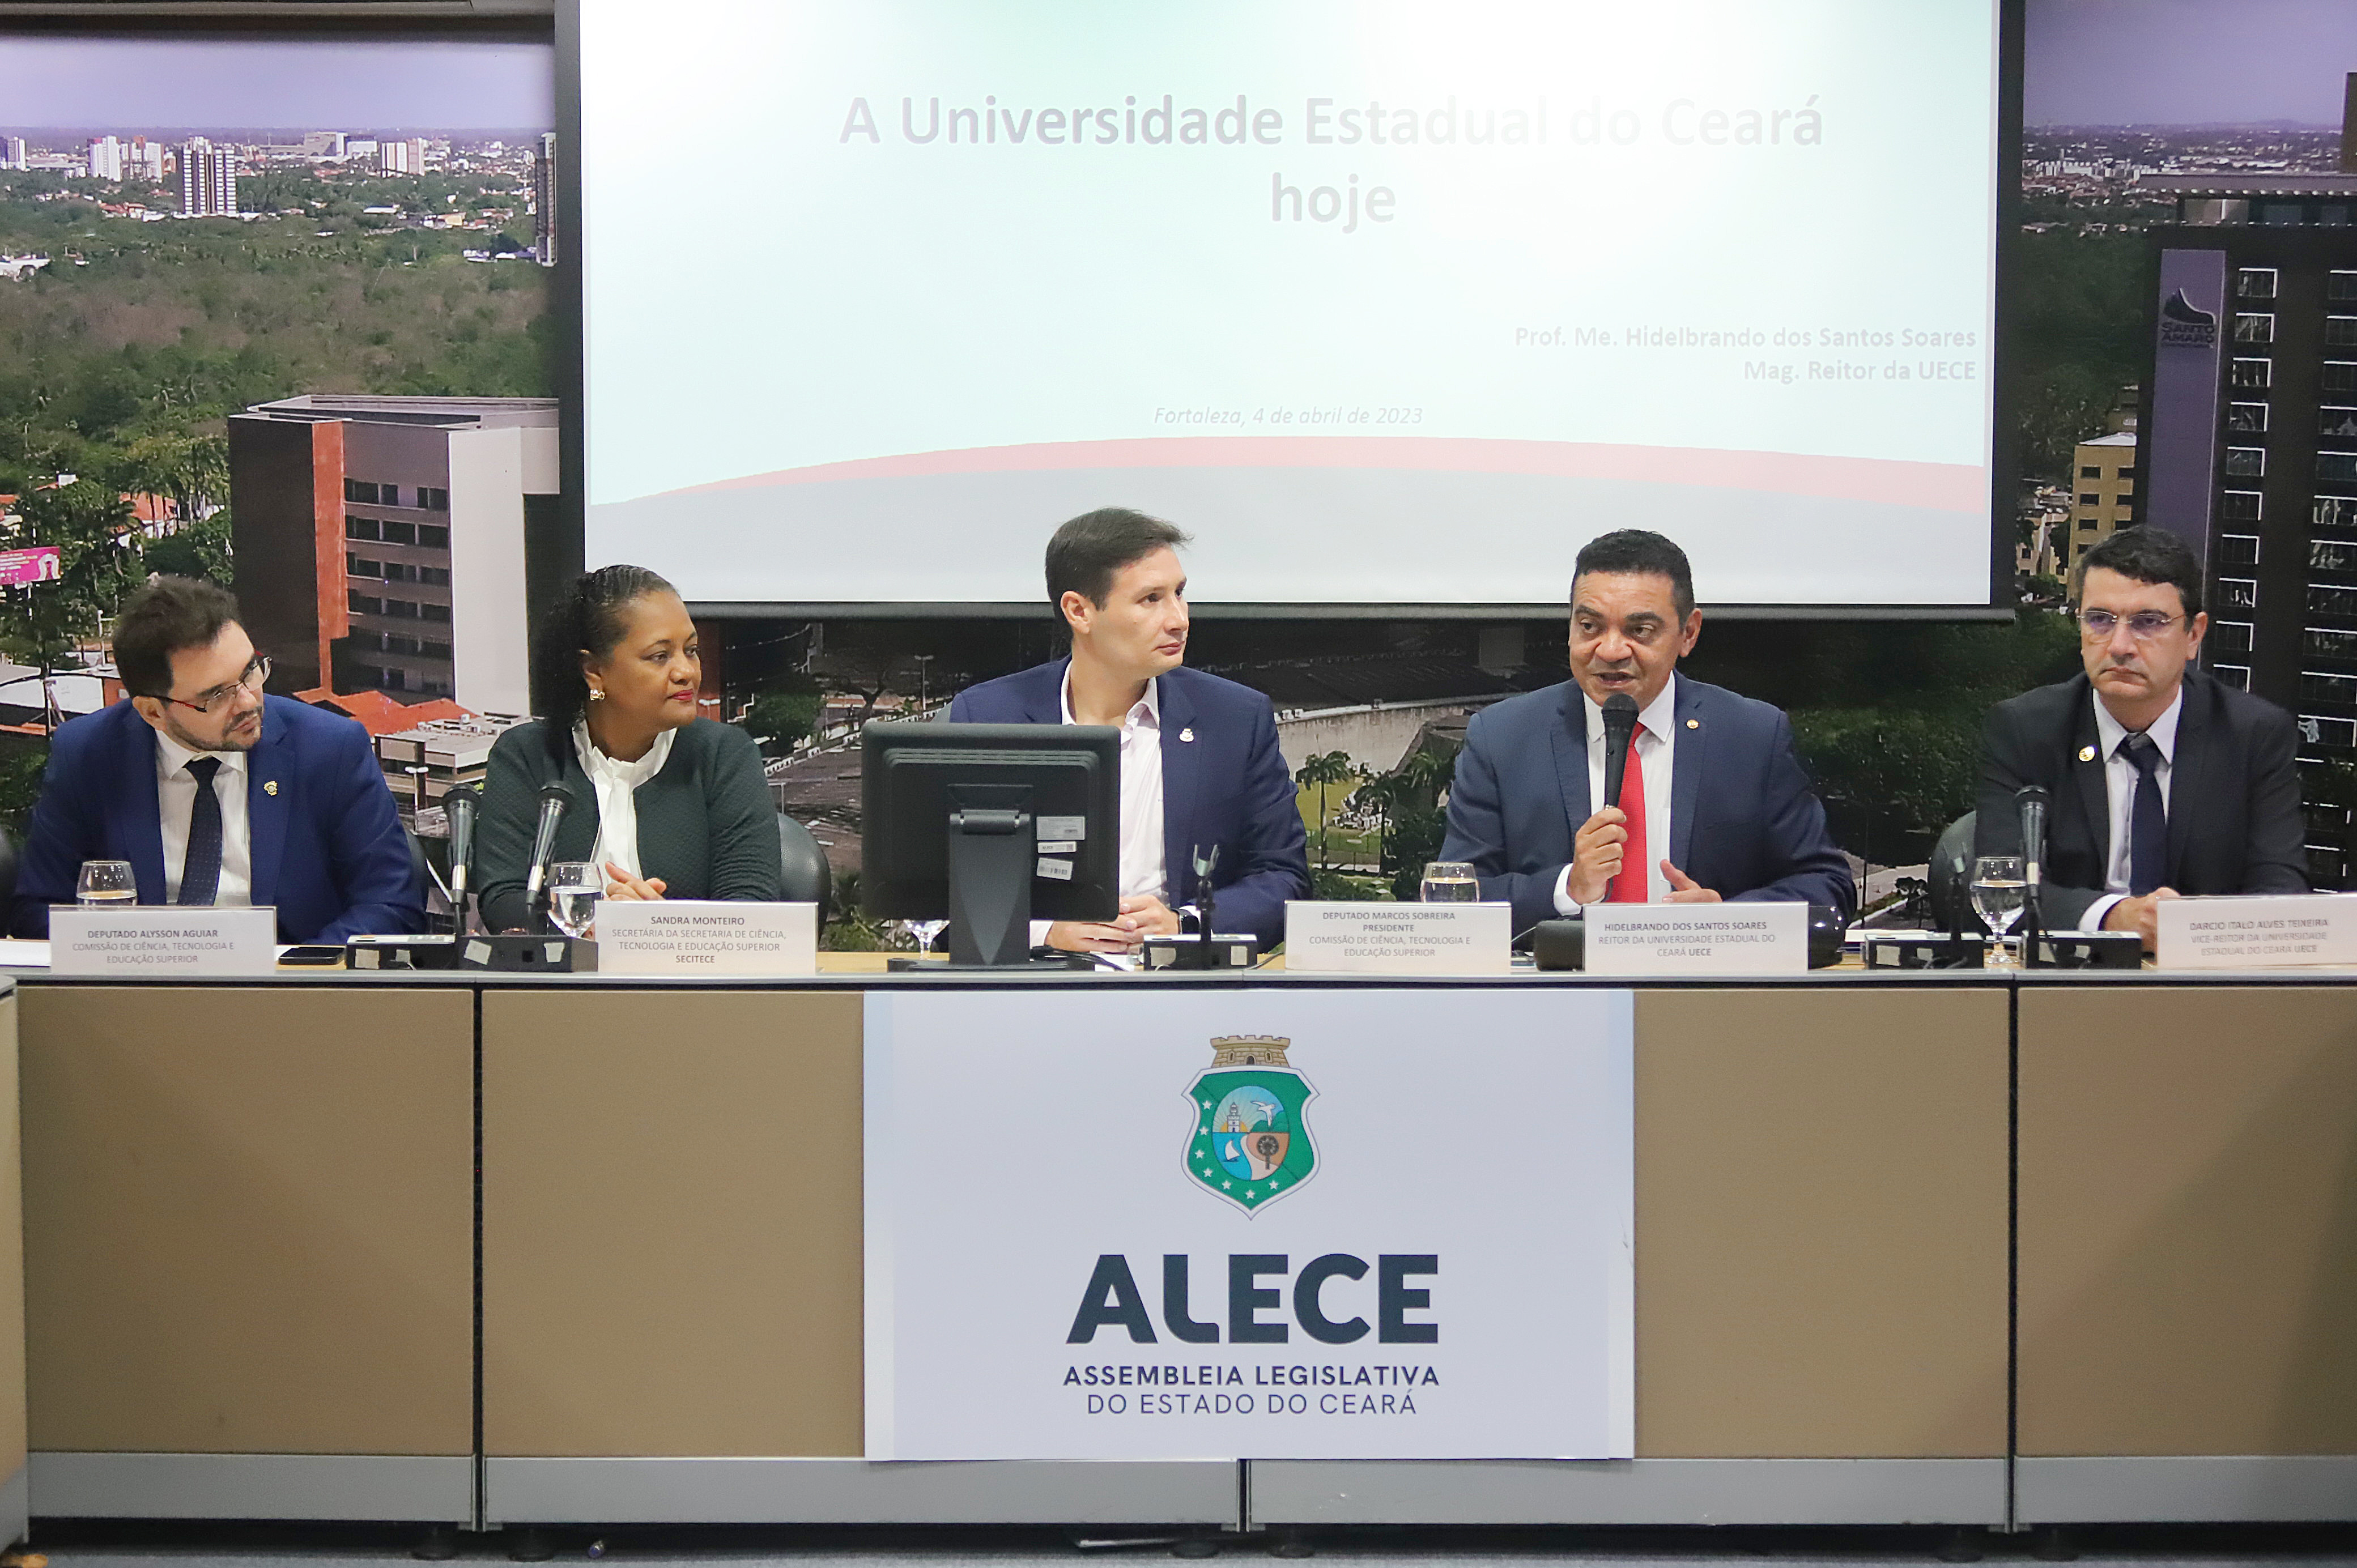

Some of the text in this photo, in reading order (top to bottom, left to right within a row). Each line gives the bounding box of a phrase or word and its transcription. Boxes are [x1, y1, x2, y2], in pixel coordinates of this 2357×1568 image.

[839, 94, 1823, 146] A Universidade Estadual do Ceará
[1271, 172, 1396, 235] hoje
[1515, 325, 1976, 348] Prof. Me. Hidelbrando dos Santos Soares
[1744, 360, 1976, 385] Mag. Reitor da UECE
[1154, 406, 1423, 428] Fortaleza, 4 de abril de 2023
[650, 916, 744, 925] SANDRA MONTEIRO
[2189, 922, 2225, 931] DARCIO
[2256, 921, 2284, 929] ALVES
[1694, 922, 1730, 931] SANTOS
[612, 928, 786, 940] SECRETÁRIA DA SECRETARIA DE CIÊNCIA,
[1598, 934, 1775, 944] REITOR DA UNIVERSIDADE ESTADUAL DO
[1309, 935, 1355, 944] COMISSÃO
[1369, 935, 1406, 945] CIÊNCIA,
[72, 941, 118, 951] COMISSÃO
[133, 941, 169, 952] CIÊNCIA,
[619, 941, 780, 952] TECNOLOGIA E EDUCAÇÃO SUPERIOR
[1344, 947, 1436, 958] EDUCAÇÃO SUPERIOR
[107, 955, 154, 965] EDUCAÇÃO
[675, 955, 716, 964] SECITECE
[1066, 1253, 1439, 1345] ALECE
[1063, 1365, 1440, 1386] ASSEMBLEIA LEGISLATIVA
[1088, 1388, 1416, 1415] DO ESTADO DO CEARÁ
